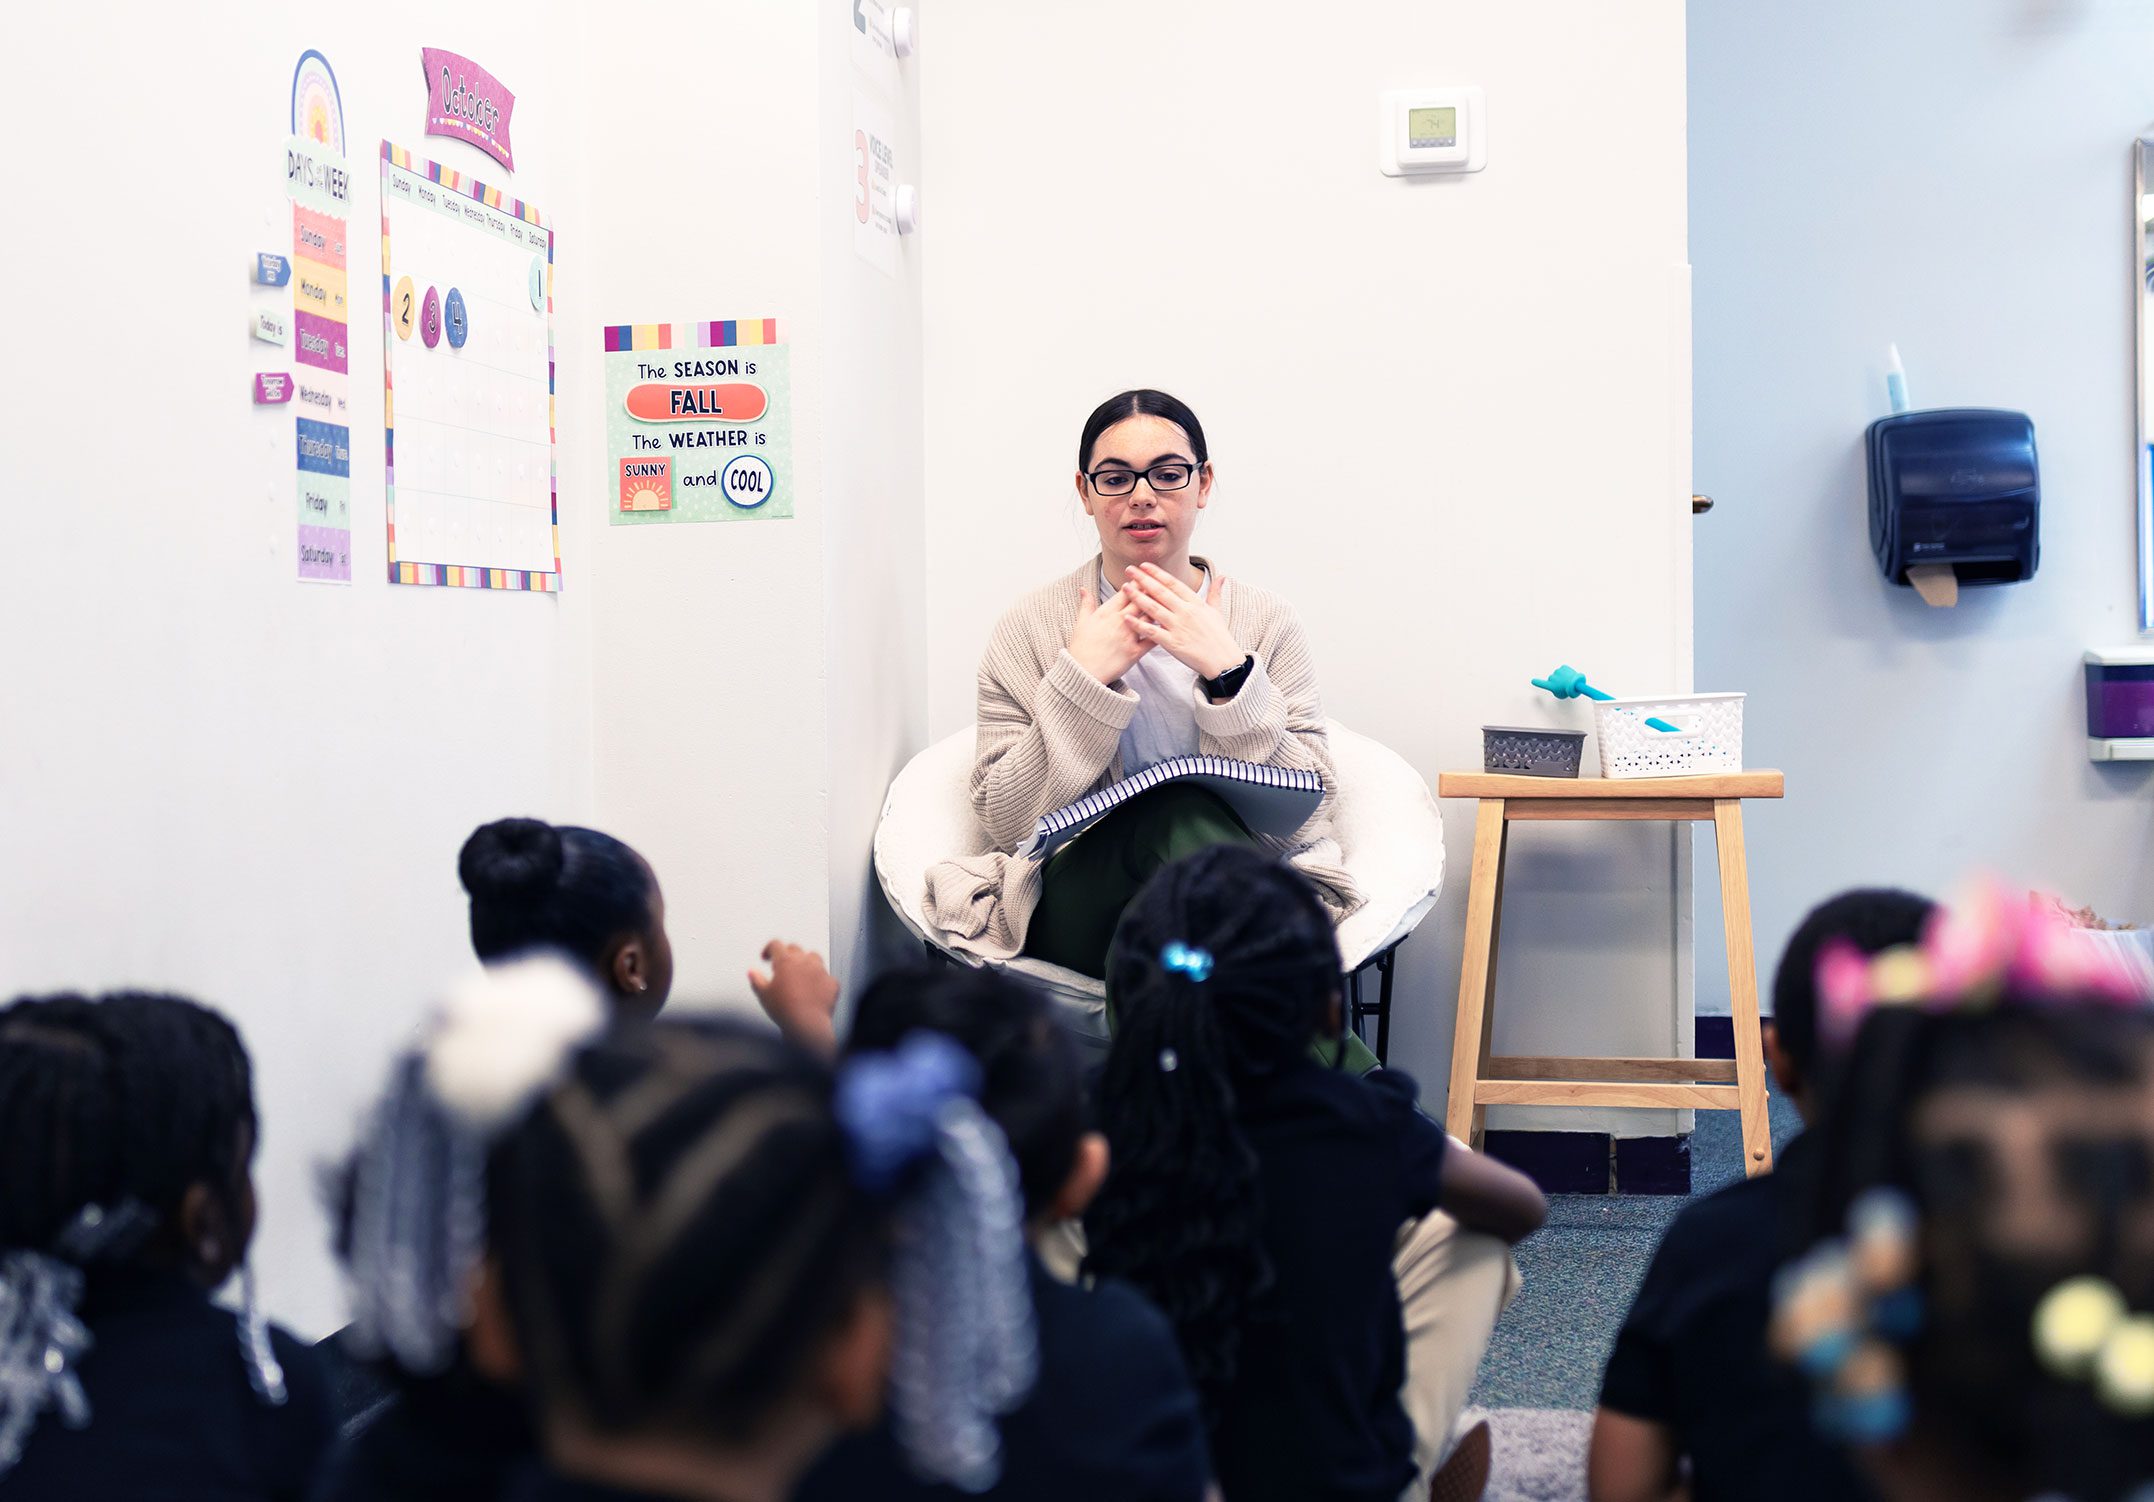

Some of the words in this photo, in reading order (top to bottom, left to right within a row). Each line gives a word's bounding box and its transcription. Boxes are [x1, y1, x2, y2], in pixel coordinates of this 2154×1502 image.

[442, 65, 499, 135] October
[288, 149, 314, 187] DAYS
[855, 128, 869, 224] 3
[323, 163, 350, 202] WEEK
[393, 173, 411, 198] Sunday
[418, 184, 436, 208] Monday
[442, 194, 460, 216] Tuesday
[511, 223, 523, 243] Friday
[529, 231, 546, 254] Saturday
[301, 224, 325, 252] Sunday
[301, 278, 326, 306] Monday
[537, 269, 542, 298] 1
[402, 292, 411, 326] 2
[429, 300, 437, 334] 3
[452, 301, 463, 335] 4
[259, 314, 276, 337] Today
[300, 329, 328, 359] Tuesday
[638, 364, 667, 379] The
[674, 359, 738, 378] SEASON
[745, 362, 757, 375] is
[300, 384, 331, 408] Wednesday
[670, 390, 722, 414] FALL
[299, 434, 332, 464] Thursday
[632, 434, 662, 450] The
[669, 430, 747, 448] WEATHER
[755, 432, 766, 445] is
[625, 464, 666, 477] SUNNY
[683, 469, 717, 487] and
[731, 469, 763, 492] COOL
[306, 492, 328, 517] Friday
[301, 544, 333, 568] Saturday
